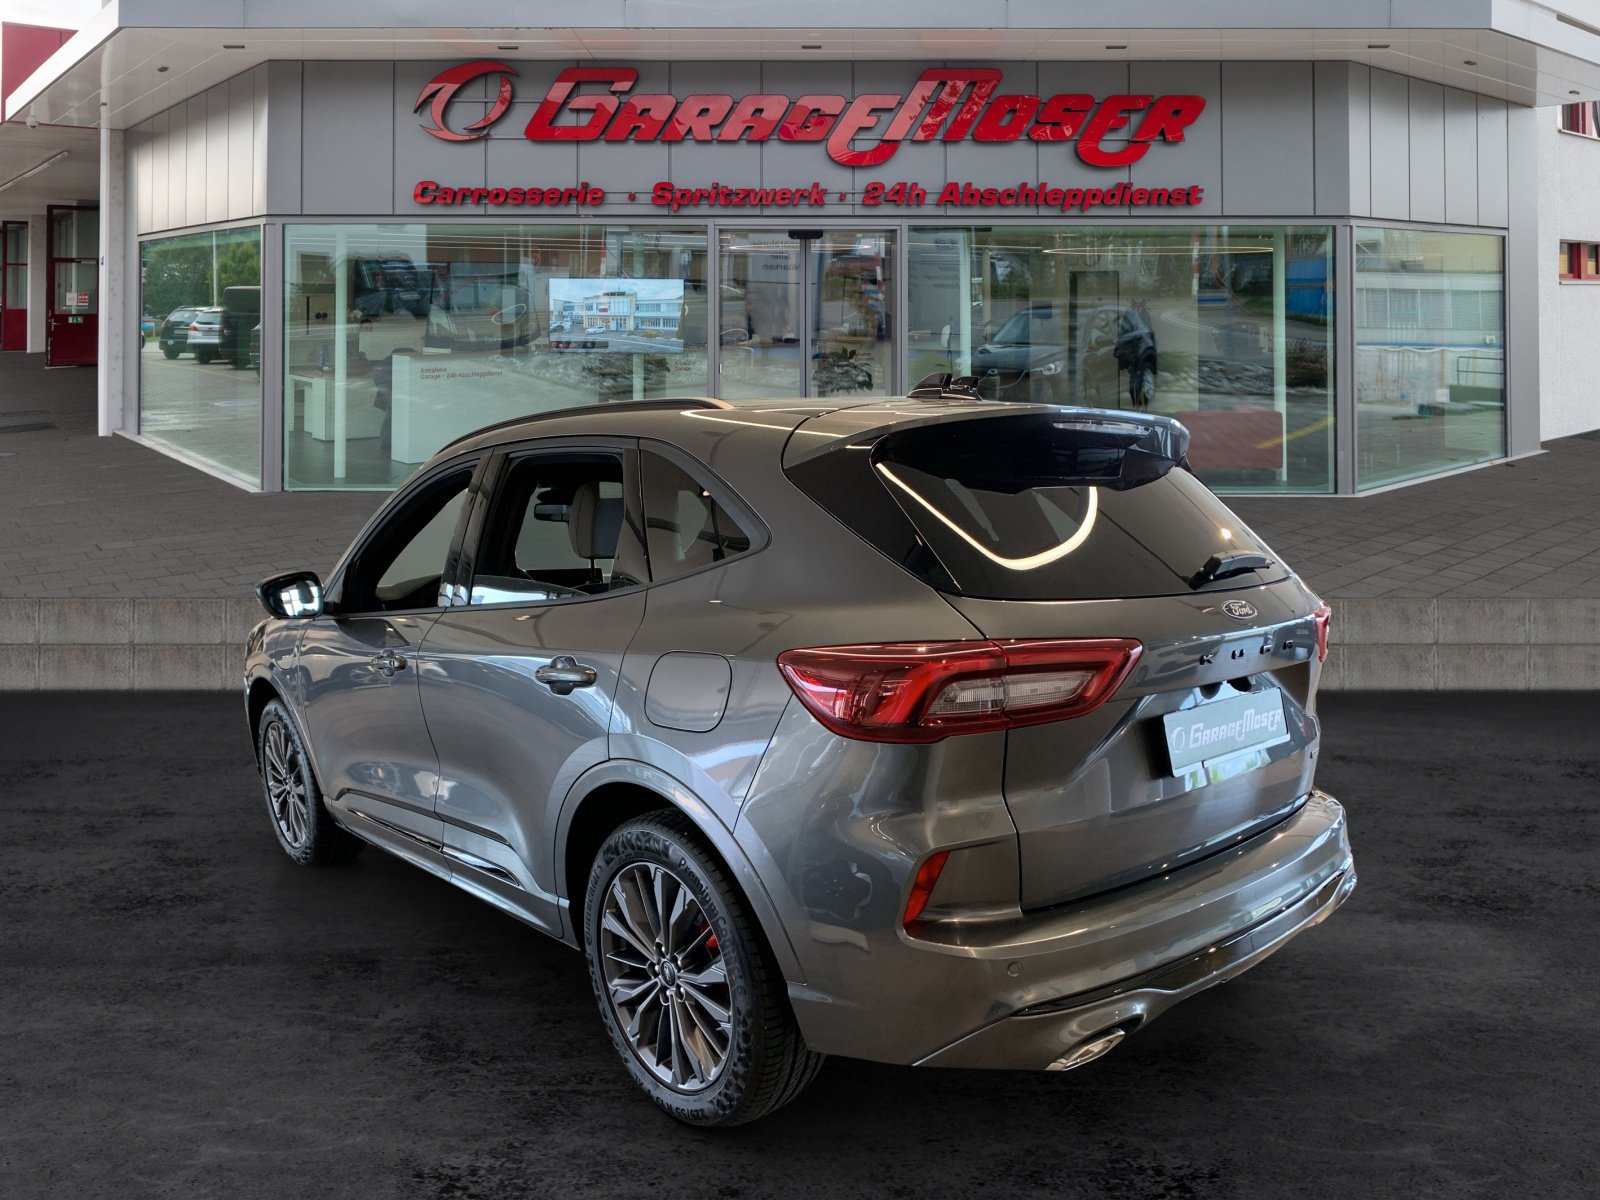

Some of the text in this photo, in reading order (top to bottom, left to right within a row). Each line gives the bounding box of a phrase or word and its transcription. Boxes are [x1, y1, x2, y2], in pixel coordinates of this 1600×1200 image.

[413, 181, 1204, 211] Carrosserie Spritzwerk 24h Abschleppdienst
